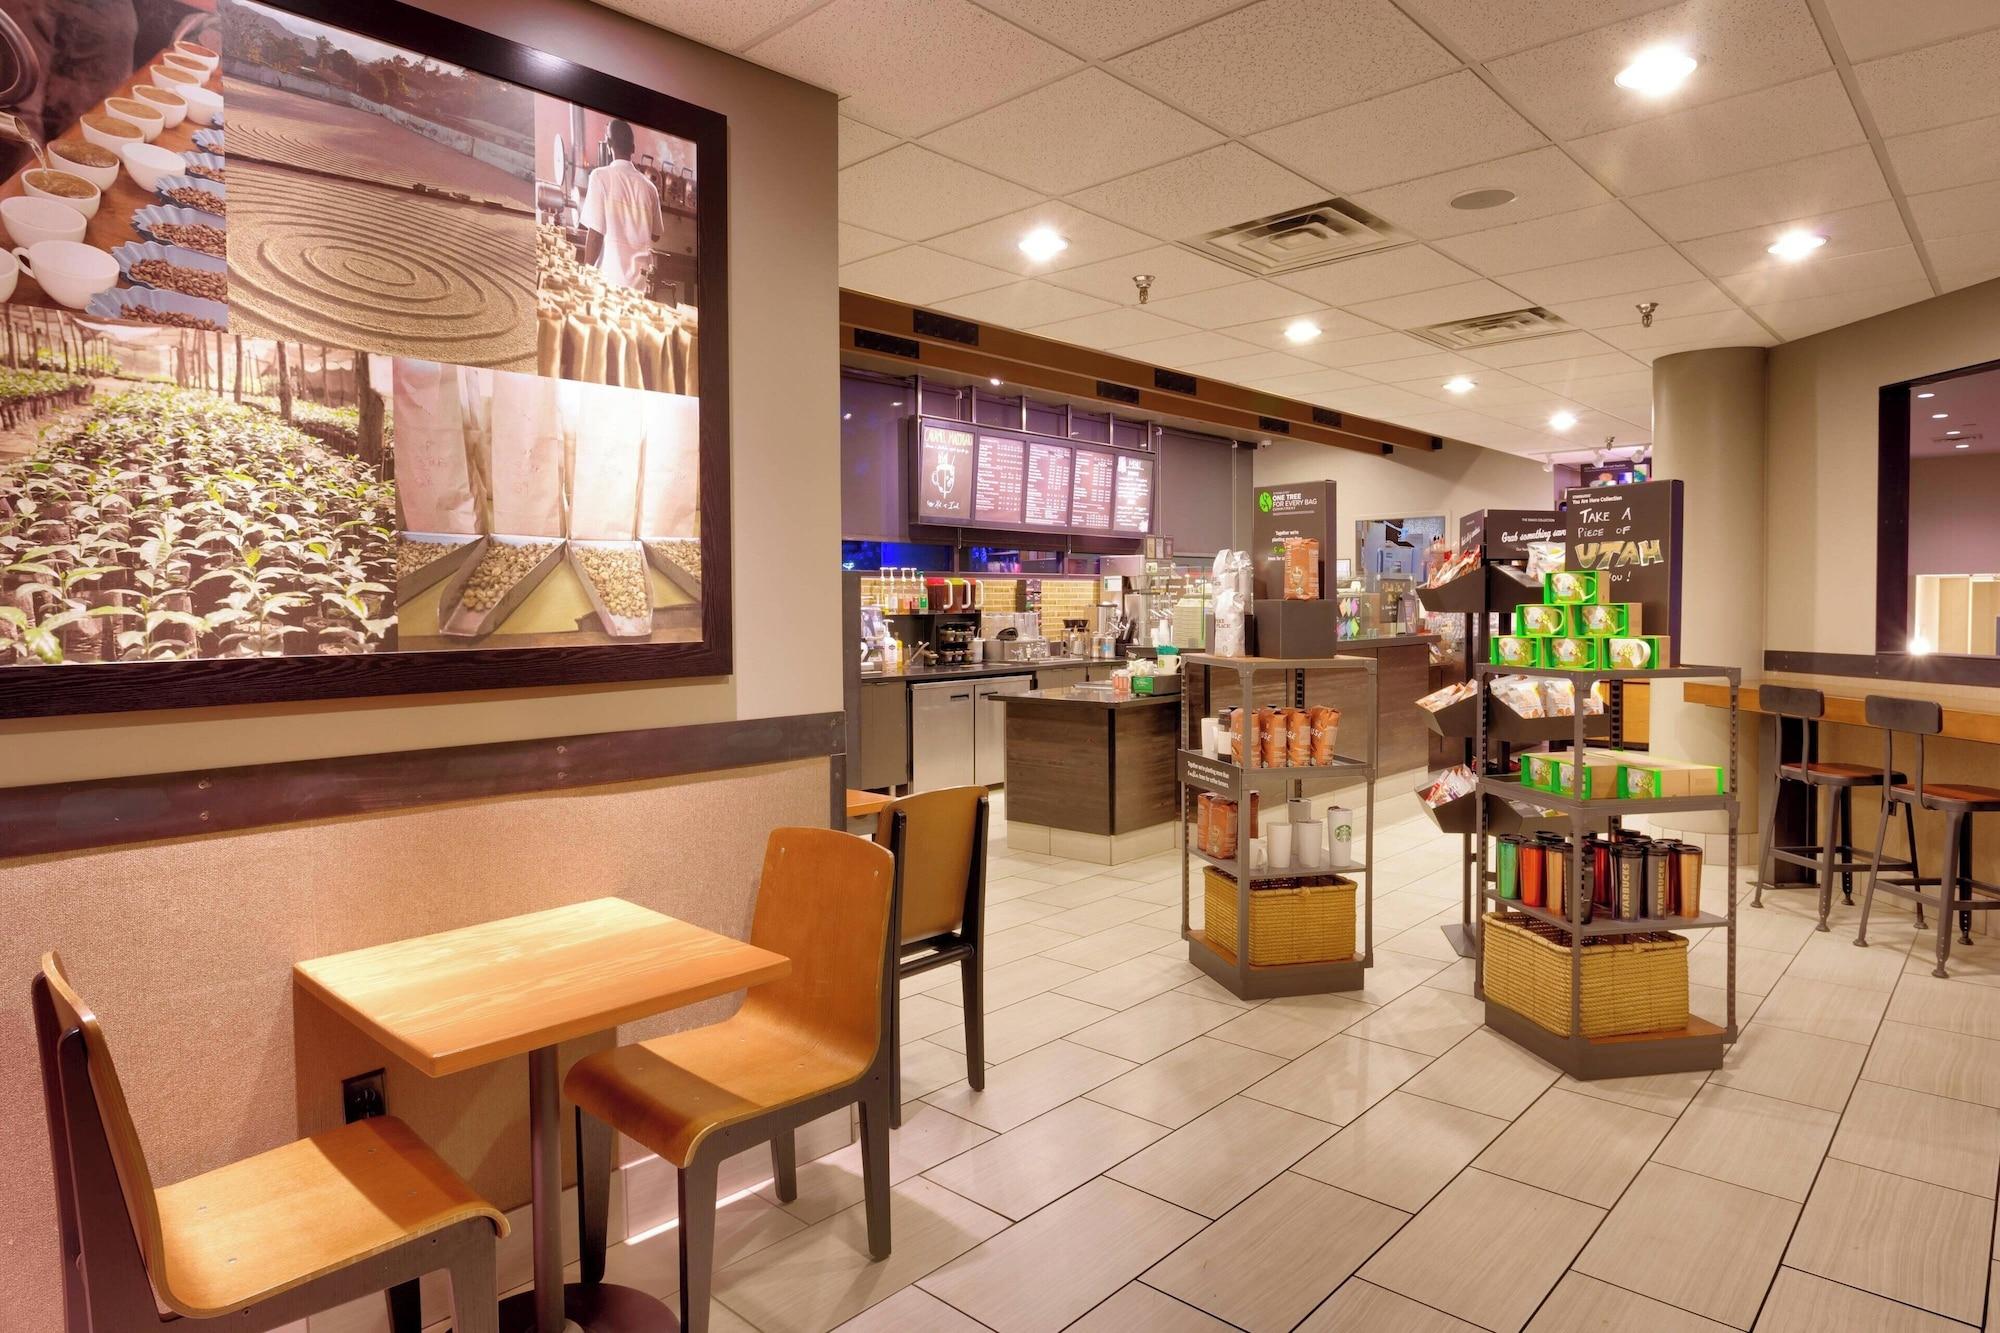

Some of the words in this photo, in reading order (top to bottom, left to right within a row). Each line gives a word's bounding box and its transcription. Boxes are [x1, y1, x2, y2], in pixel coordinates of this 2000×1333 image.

[1285, 499, 1304, 507] EVERY
[1304, 498, 1318, 506] BAG
[1579, 507, 1610, 524] TAKE
[1621, 506, 1632, 521] A
[1501, 531, 1518, 543] Grab
[1519, 527, 1552, 542] something
[1615, 525, 1632, 535] OF
[1574, 539, 1664, 570] UTAH
[1622, 863, 1630, 918] STARBUCKS
